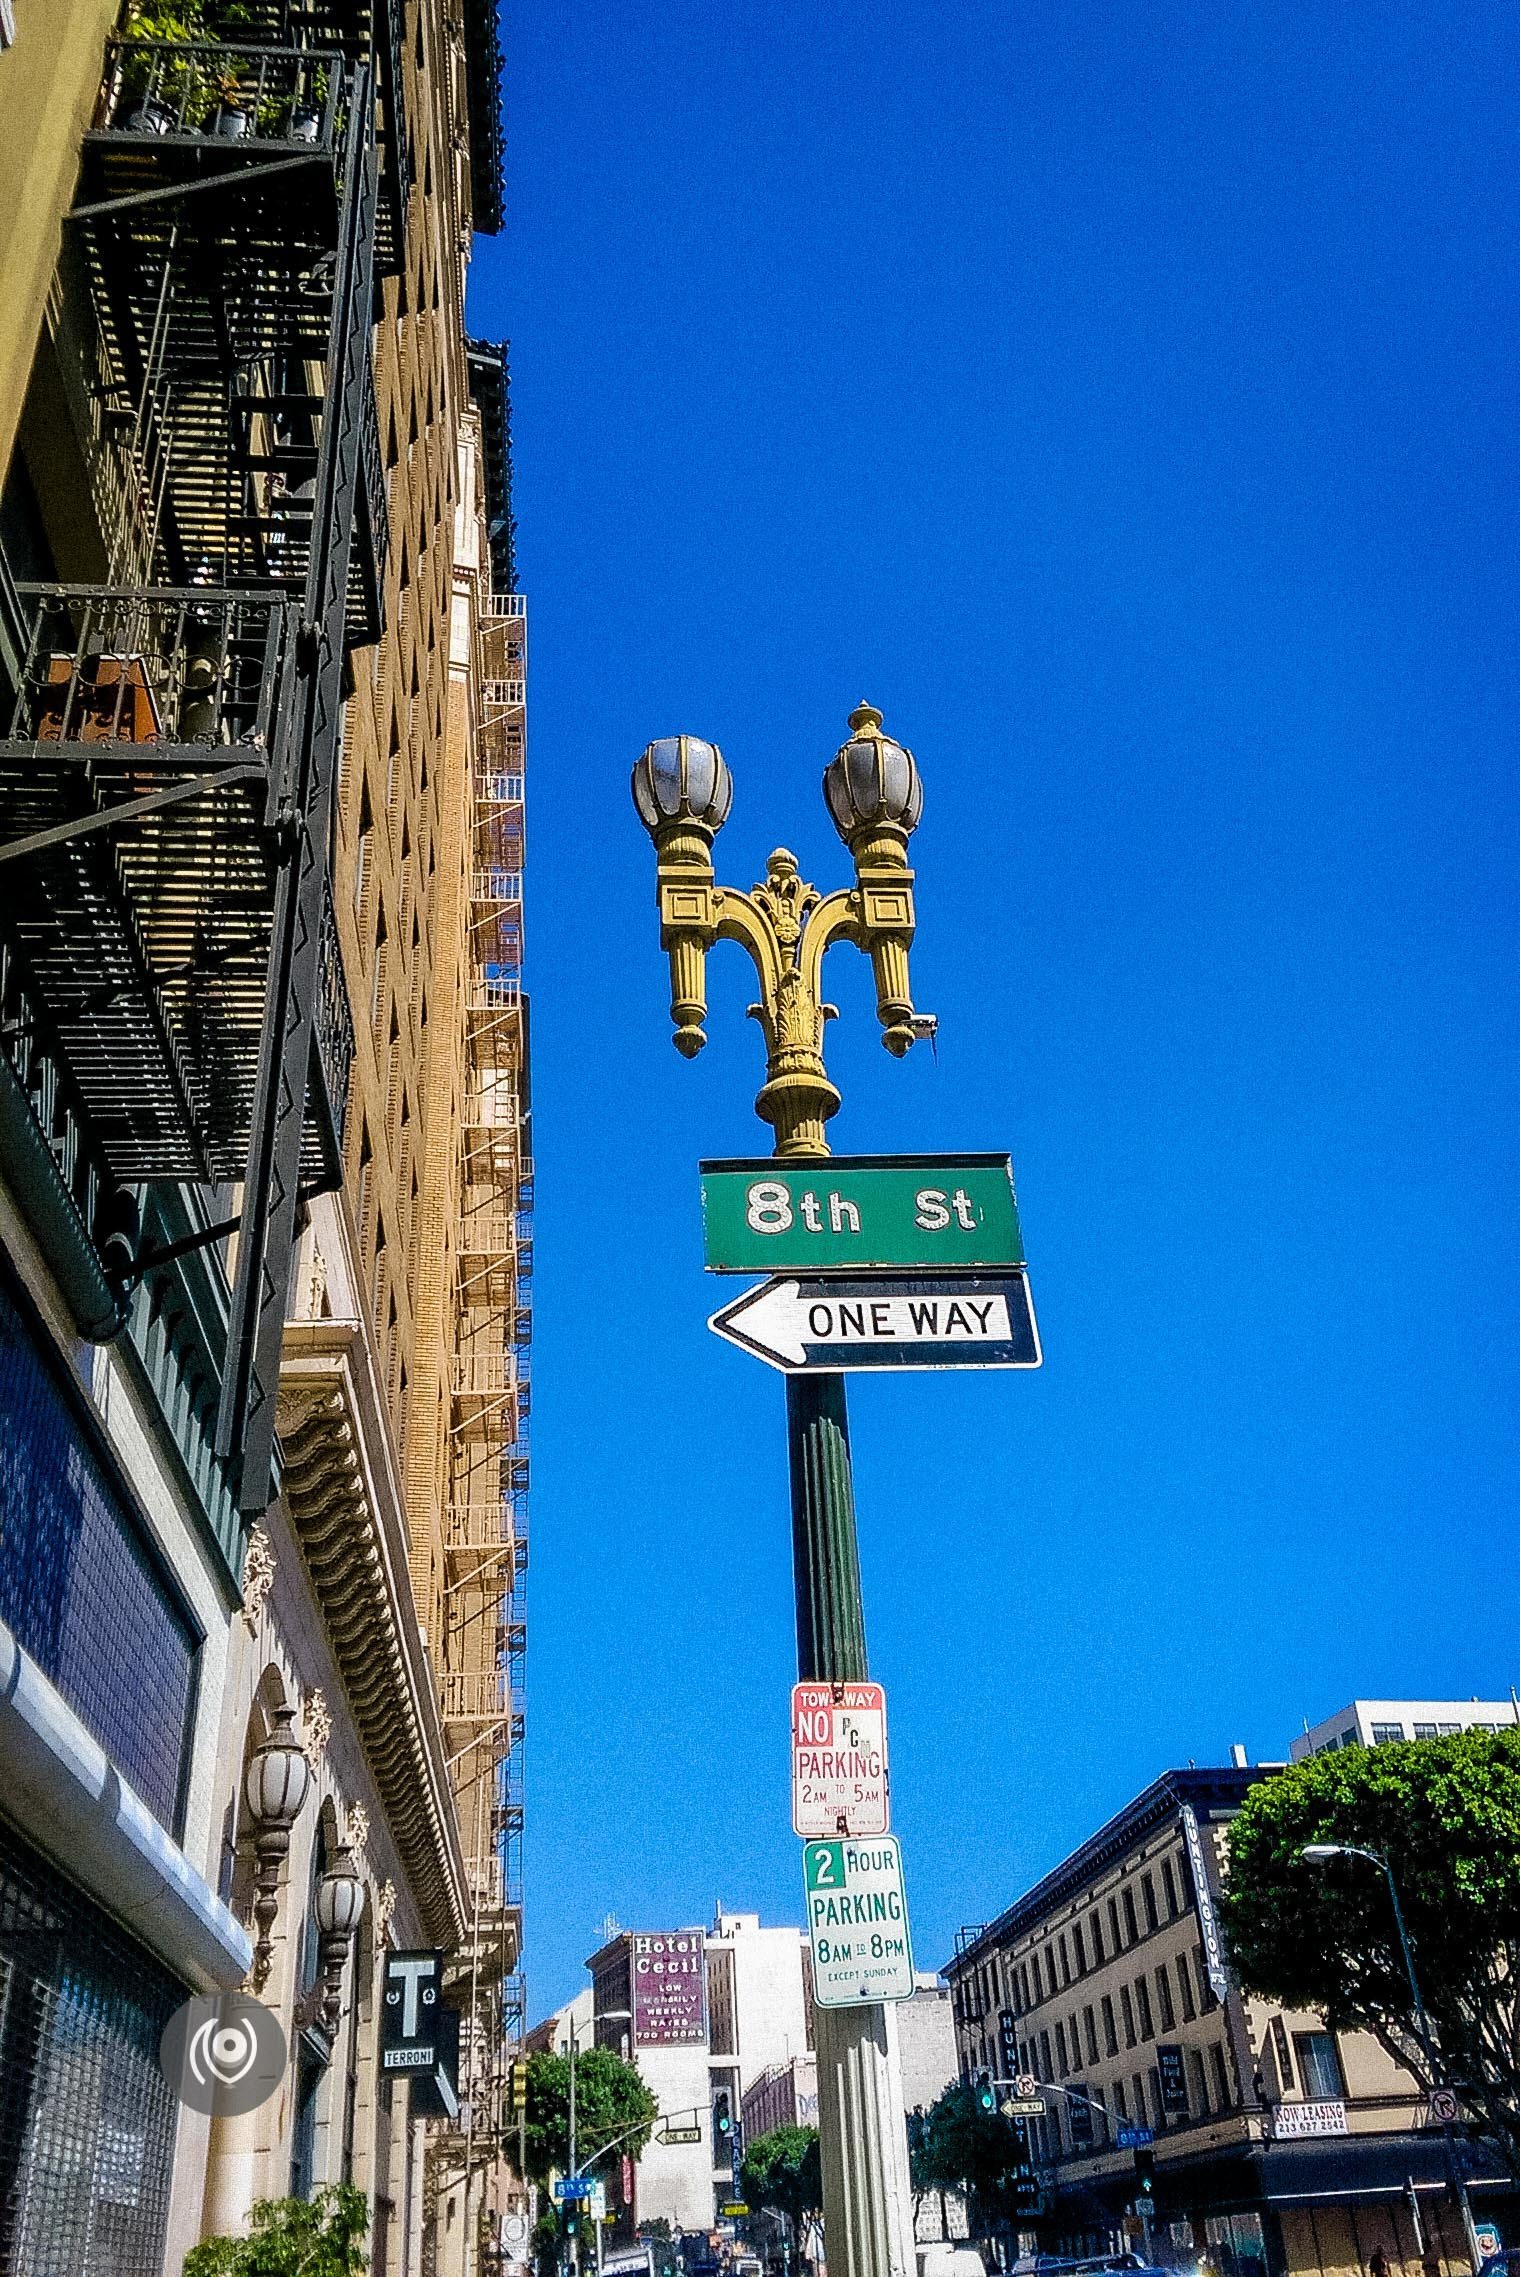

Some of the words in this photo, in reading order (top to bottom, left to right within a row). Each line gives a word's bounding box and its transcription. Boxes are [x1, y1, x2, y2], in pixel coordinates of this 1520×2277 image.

[747, 1181, 861, 1234] 8th
[915, 1188, 977, 1232] St
[808, 1302, 896, 1338] ONE
[908, 1301, 994, 1336] WAY
[798, 1710, 829, 1743] NO
[799, 1751, 881, 1779] PARKING
[836, 1784, 846, 1795] TO
[823, 1805, 857, 1817] NIGHTLY
[814, 1848, 836, 1885] 2
[847, 1850, 895, 1873] HOUR
[813, 1891, 901, 1928] PARKING
[635, 1936, 699, 1954] Hotel
[856, 1943, 867, 1956] TO
[636, 1956, 699, 1974] Cecil
[828, 1970, 860, 1982] EXCEPT
[863, 1967, 898, 1979] SUNDAY
[659, 1984, 682, 1992] LOW
[388, 1960, 435, 2038] T
[647, 2007, 693, 2016] WEEKLY
[650, 2018, 689, 2027] RATES
[636, 2031, 658, 2040] 700
[664, 2029, 704, 2039] ROOMS
[386, 2050, 432, 2066] TERRONI
[1276, 2106, 1299, 2123] NOW
[1301, 2104, 1343, 2121] LEASING
[682, 2131, 697, 2140] WAY
